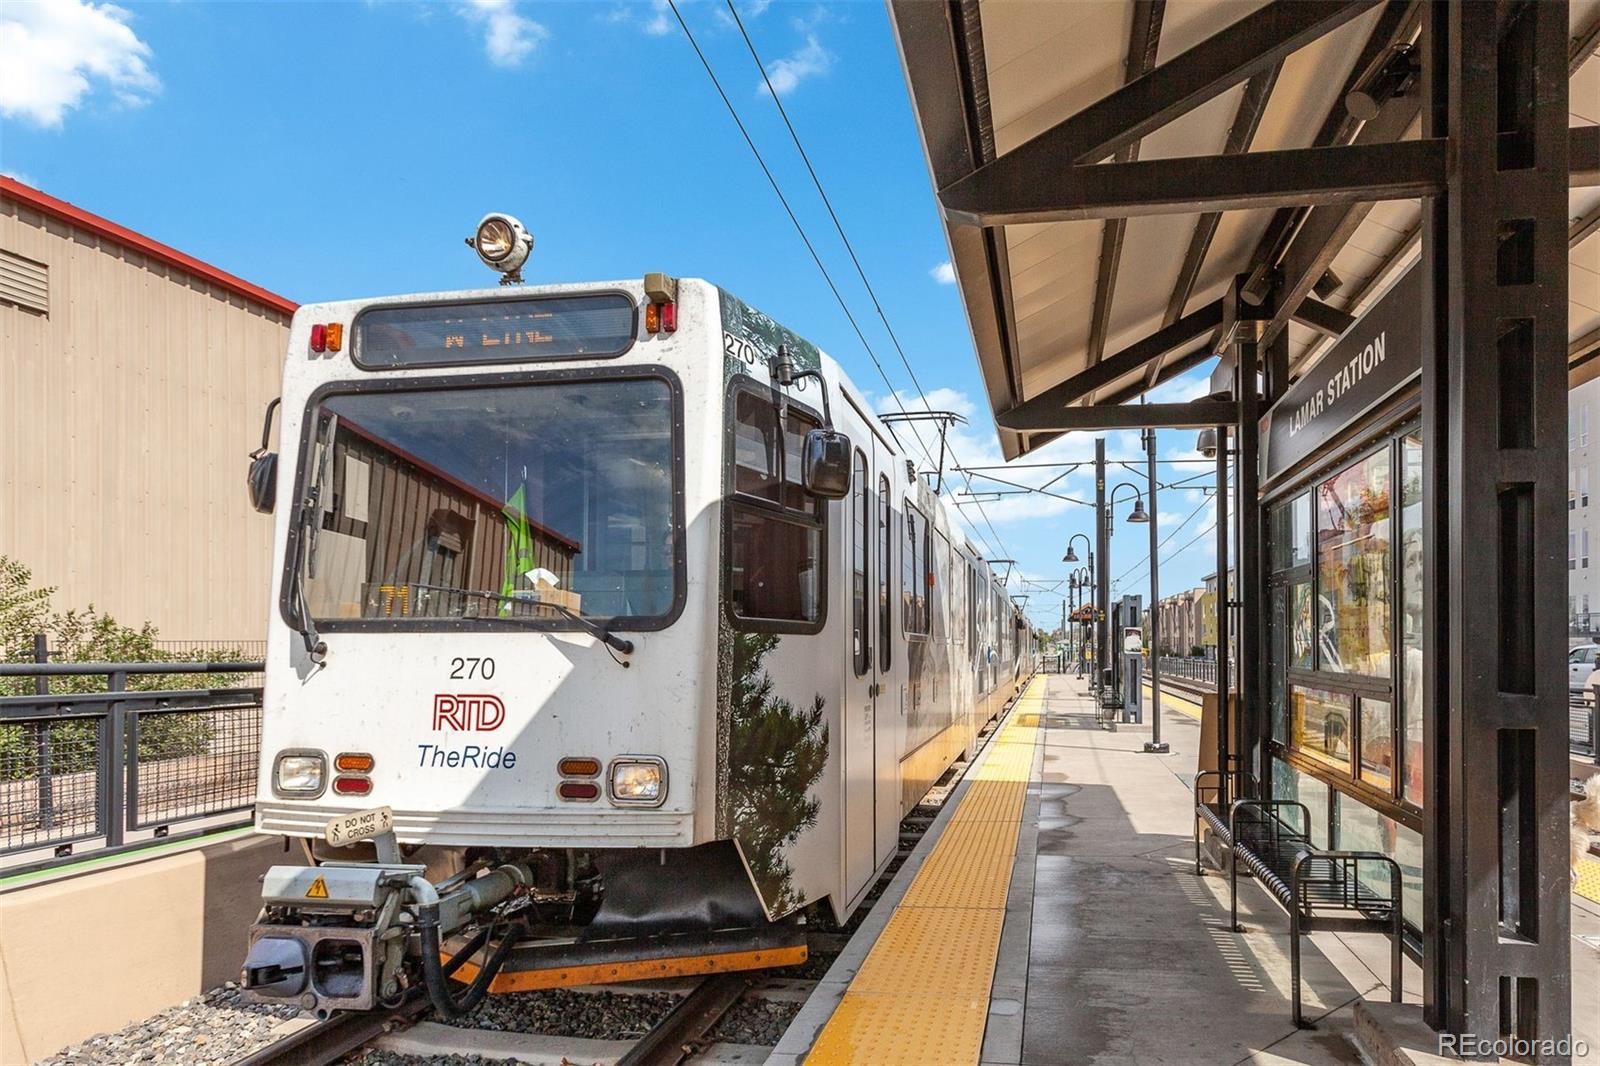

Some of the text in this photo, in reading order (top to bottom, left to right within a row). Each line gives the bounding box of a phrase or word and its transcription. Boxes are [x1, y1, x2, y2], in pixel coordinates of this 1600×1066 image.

[725, 333, 754, 365] 270
[1289, 331, 1386, 438] LAMAR STATION
[450, 657, 495, 680] 270
[432, 694, 505, 731] RTD
[418, 744, 516, 769] TheRide
[345, 813, 375, 829] DO NOT
[347, 824, 376, 838] CROSS
